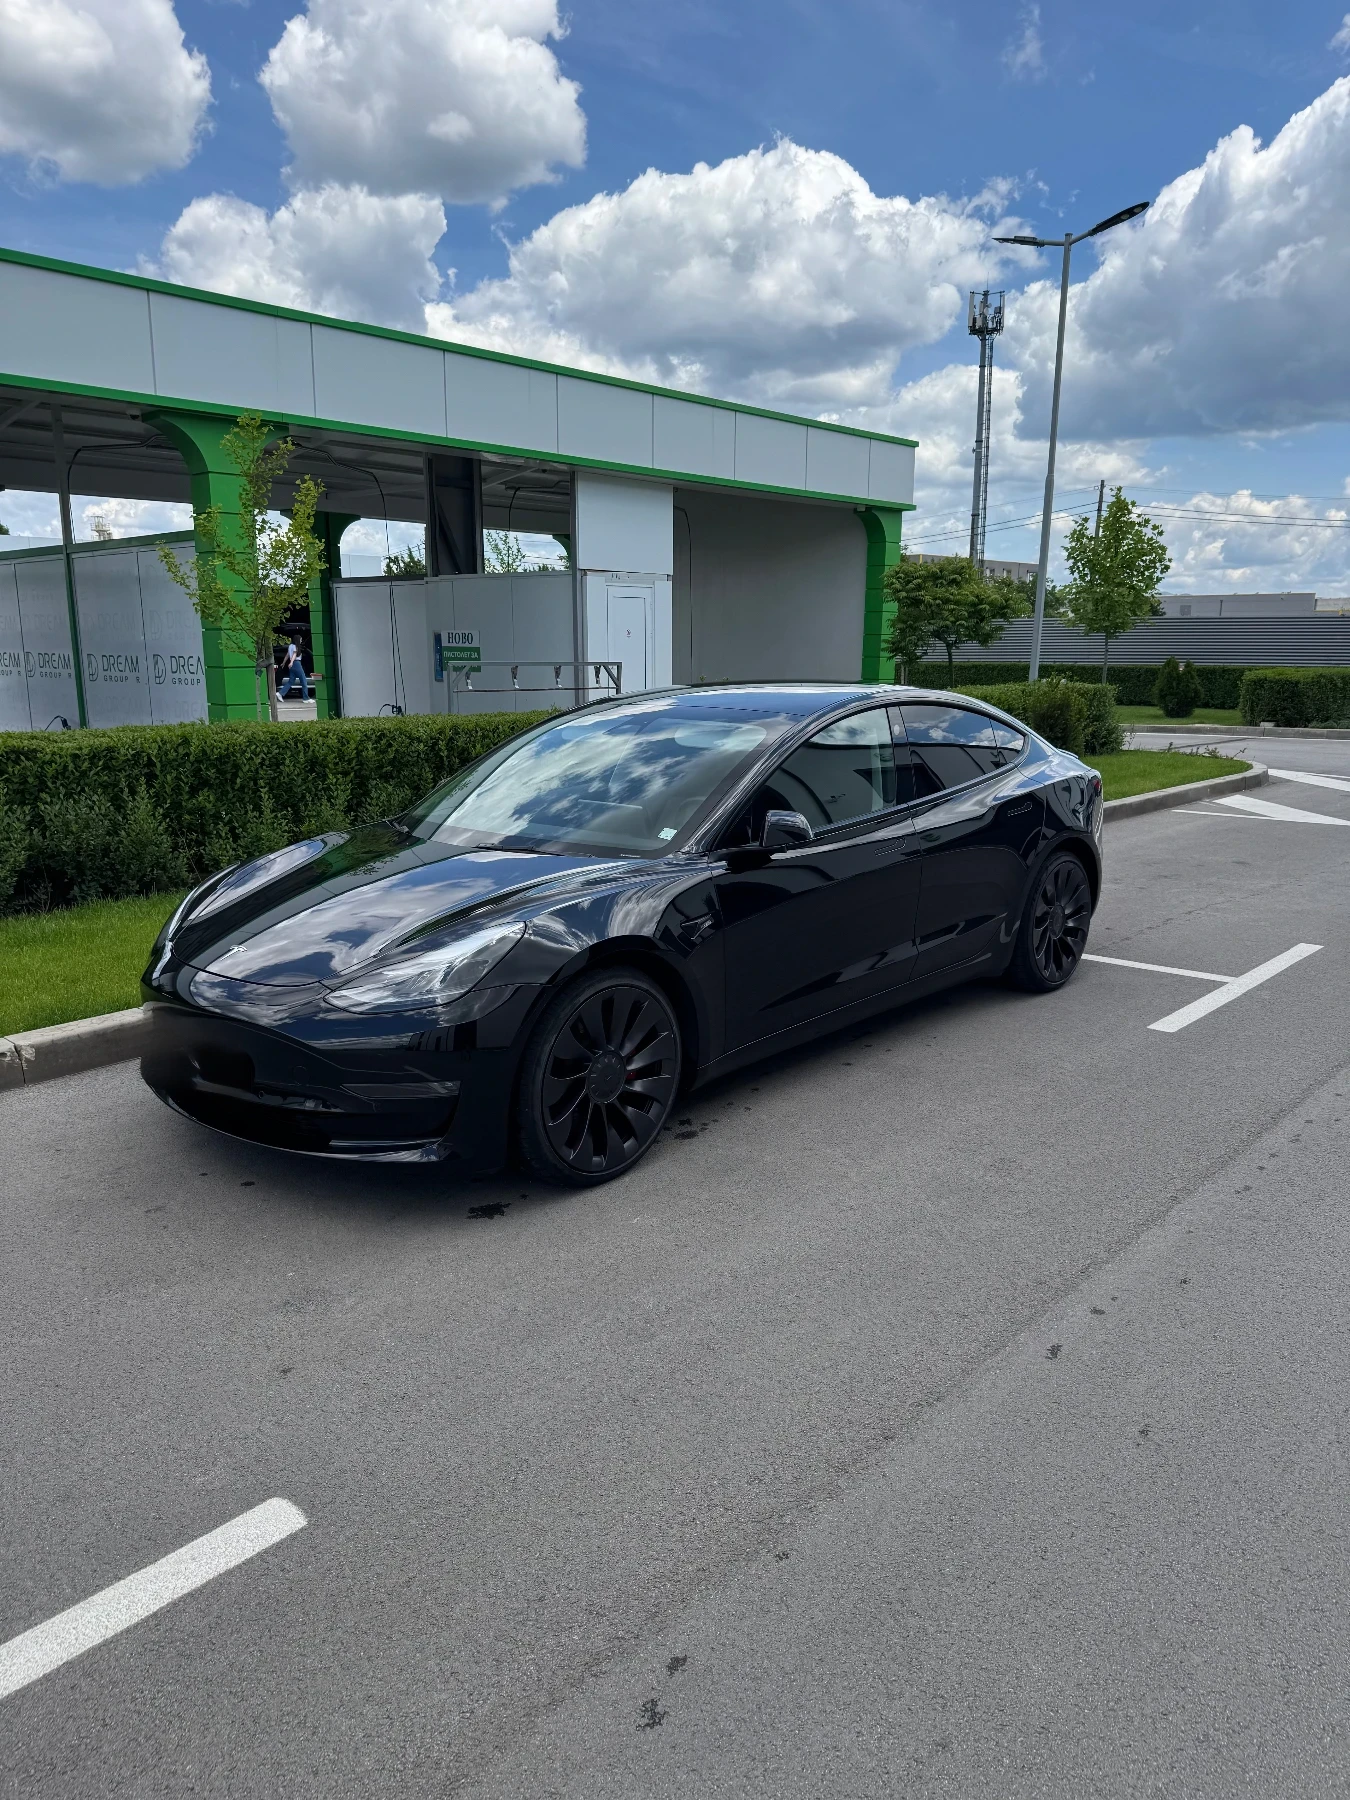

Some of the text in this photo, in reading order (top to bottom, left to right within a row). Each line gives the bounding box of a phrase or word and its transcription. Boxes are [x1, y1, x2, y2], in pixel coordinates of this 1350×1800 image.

[447, 632, 474, 644] НОВО
[38, 652, 72, 670] DREAM
[102, 654, 140, 673] DREAM
[40, 671, 62, 679] GROUP
[103, 675, 129, 683] GROUP
[171, 677, 201, 686] GROUP
